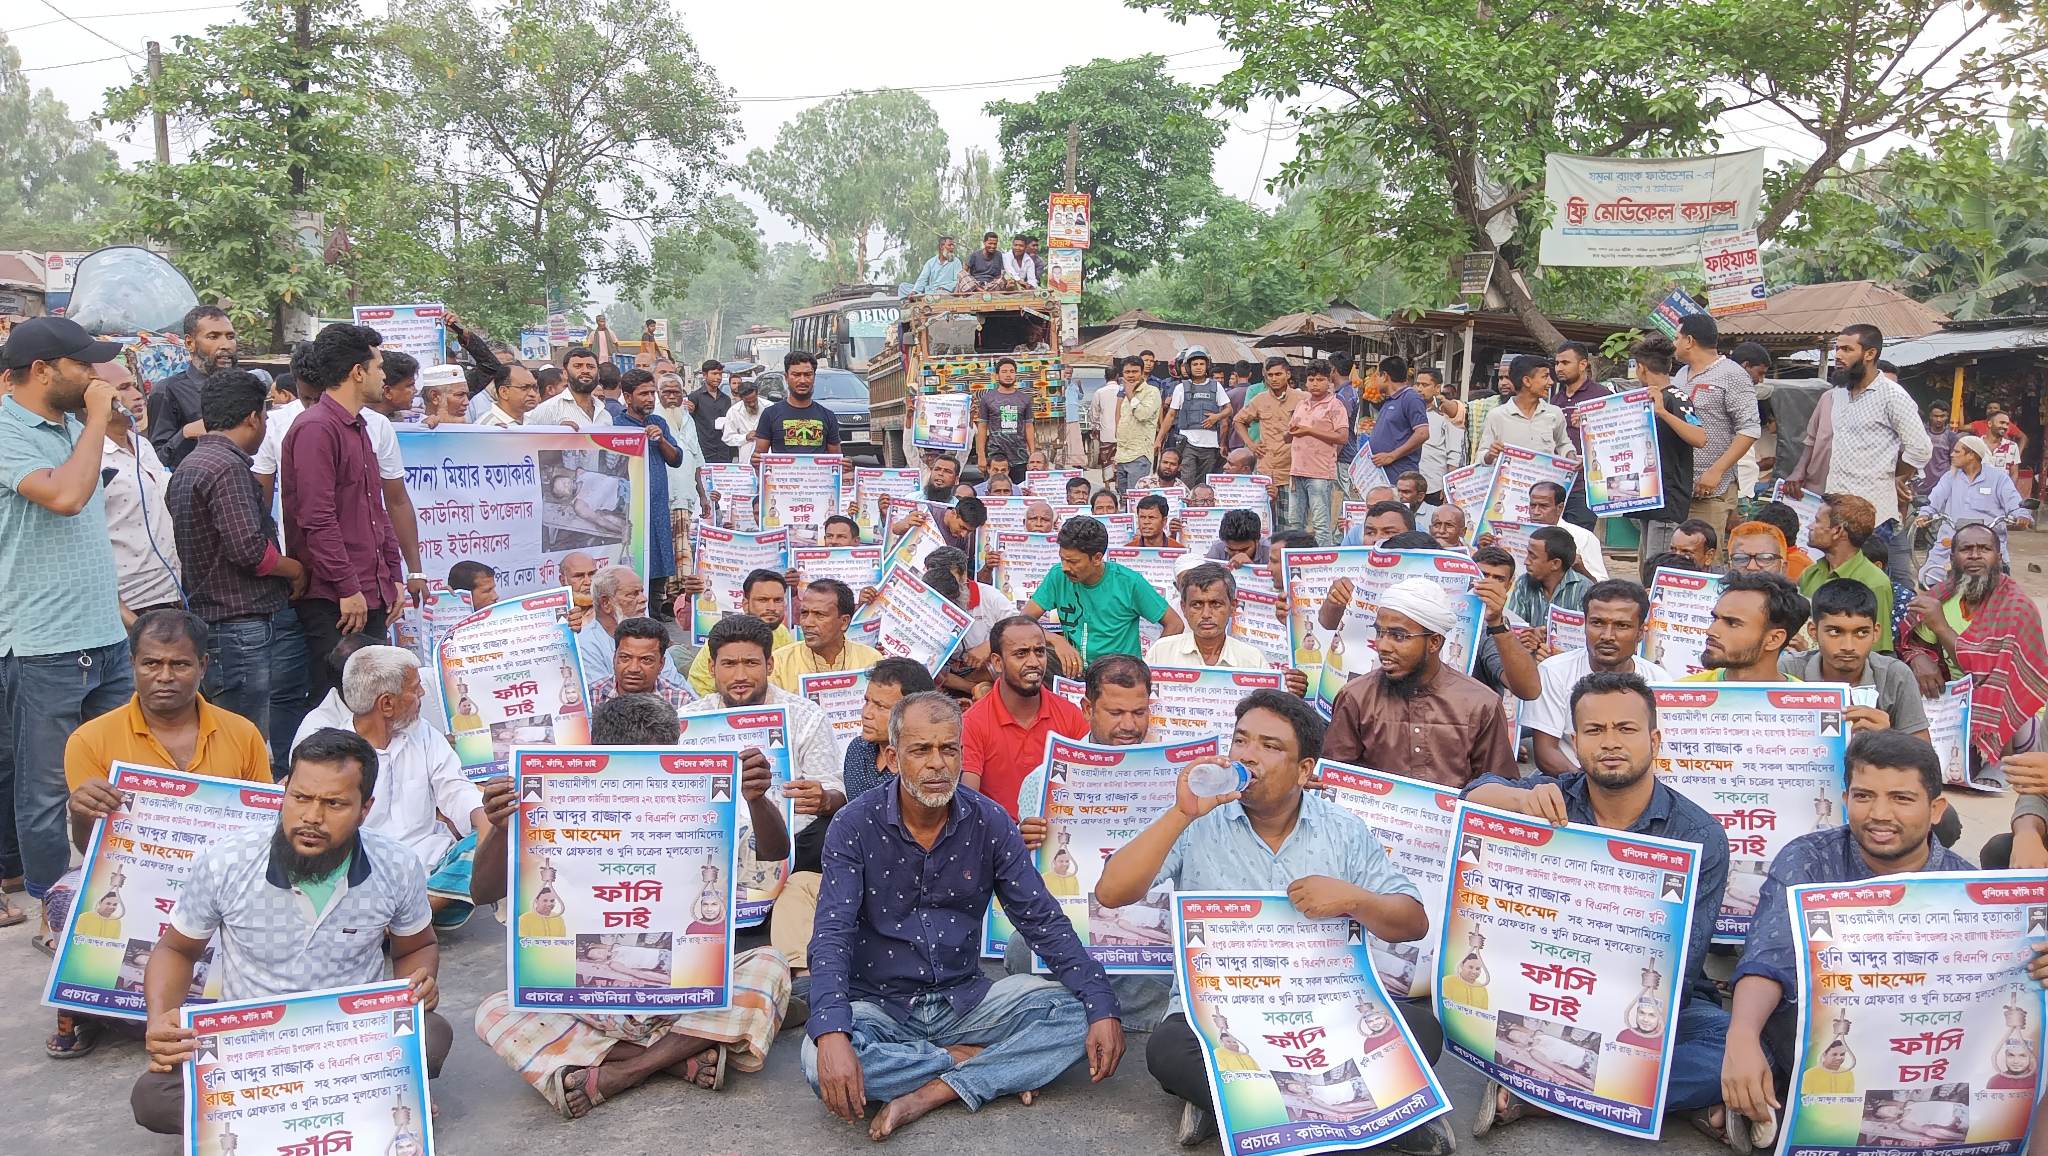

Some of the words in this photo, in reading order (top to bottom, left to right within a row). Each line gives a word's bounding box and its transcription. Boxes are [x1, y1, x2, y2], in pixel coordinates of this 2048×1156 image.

[1567, 196, 1589, 225] ফ্রি
[1594, 196, 1676, 223] মেডিকেল
[1680, 198, 1740, 222] ক্যাম্প
[1705, 249, 1757, 272] ফাইয়াজ
[860, 308, 900, 321] BINO
[1610, 450, 1634, 462] ফাঁসি
[442, 458, 480, 488] মিয়ার
[483, 456, 536, 490] হত্যাকারী
[1615, 462, 1631, 474] চাই
[418, 500, 474, 525] কাউনিয়া
[480, 500, 533, 520] উপজেলার
[788, 503, 815, 512] ফাঁসি
[447, 530, 510, 555] ইউনিয়নের
[513, 567, 536, 587] নেতা
[539, 560, 555, 585] খুনি
[884, 633, 912, 658] ফাঁসি
[493, 681, 538, 701] ফাঁসি
[504, 699, 534, 716] চাই
[1170, 717, 1208, 728] আহম্মেদ
[1668, 742, 1699, 756] আব্দুর
[1703, 742, 1742, 754] রাজ্জাক
[1676, 757, 1734, 772] আহম্মেদ
[547, 776, 596, 788] আওয়ামীলীগ
[600, 780, 619, 788] নেতা
[623, 780, 643, 788] সোনা
[646, 777, 668, 788] মিয়ার
[671, 776, 707, 789] হত্যাকারী
[1052, 790, 1069, 803] খুনি
[1073, 793, 1102, 803] আব্দুর
[1105, 793, 1139, 801] রাজ্জাক
[1713, 792, 1769, 804] সকলের
[526, 808, 548, 826] খুনি
[553, 810, 587, 826] আব্দুর
[591, 810, 632, 823] রাজ্জাক
[645, 812, 676, 823] বিএনপি
[680, 814, 698, 822] নেতা
[702, 811, 720, 824] খুনি
[1050, 804, 1074, 816] রাজু
[1079, 804, 1128, 815] আহম্মেদ
[111, 817, 133, 837] খুনি
[137, 826, 168, 842] আব্দুর
[172, 831, 207, 845] রাজ্জাক
[529, 829, 556, 844] রাজু
[561, 829, 621, 842] আহম্মেদ
[630, 832, 645, 841] সহ
[648, 832, 672, 840] সকল
[675, 830, 723, 839] আসামিদের
[108, 836, 134, 852] রাজু
[140, 840, 195, 862] আহম্মেদ
[529, 846, 562, 856] অবিলম্বে
[566, 847, 602, 856] গ্রেফতার
[606, 848, 613, 856] ও
[617, 845, 633, 858] খুনি
[636, 848, 662, 856] চক্রের
[666, 847, 703, 858] মূলহোতা
[707, 846, 719, 856] সহ
[598, 863, 656, 875] সকলের
[1486, 843, 1537, 861] আওয়ামীলীগ
[1541, 855, 1561, 866] নেতা
[1565, 859, 1587, 871] সোনা
[1591, 860, 1615, 876] মিয়ার
[1618, 868, 1658, 883] হত্যাকারী
[592, 879, 663, 904] ফাঁসি
[1460, 869, 1484, 890] খুনি
[1488, 877, 1523, 897] আব্দুর
[1528, 885, 1572, 904] রাজ্জাক
[603, 907, 651, 930] চাই
[1461, 892, 1489, 912] রাজু
[1494, 898, 1558, 922] আহম্মেদ
[1568, 915, 1583, 927] সহ
[1587, 919, 1613, 932] সকল
[1616, 924, 1671, 942] আসামিদের
[1460, 908, 1494, 926] অবিলম্বে
[1498, 918, 1536, 932] গ্রেফতার
[1540, 927, 1547, 935] ও
[1552, 927, 1569, 940] খুনি
[1572, 933, 1600, 946] চক্রের
[1604, 939, 1646, 955] মূলহোতা
[1650, 948, 1664, 961] সহ
[1092, 950, 1138, 964] কাউনিয়া
[1192, 953, 1211, 974] খুনি
[1215, 957, 1247, 972] আব্দুর
[1251, 956, 1289, 968] রাজ্জাক
[1531, 940, 1592, 965] সকলের
[1817, 947, 1842, 968] খুনি
[1848, 952, 1887, 970] আব্দুর
[1892, 952, 1939, 966] রাজ্জাক
[1196, 977, 1222, 992] রাজু
[1224, 975, 1281, 989] আহম্মেদ
[1521, 963, 1597, 995] ফাঁসি
[1822, 974, 1854, 991] রাজু
[1858, 973, 1927, 989] আহম্মেদ
[526, 992, 564, 1006] প্রচারে
[578, 990, 631, 1006] কাউনিয়া
[634, 988, 716, 1006] উপজেলাবাসী
[1529, 993, 1581, 1022] চাই
[1263, 1011, 1314, 1025] সকলের
[1900, 1011, 1963, 1026] সকলের
[1262, 1026, 1326, 1050] ফাঁসি
[1889, 1028, 1964, 1055] ফাঁসি
[1283, 1048, 1329, 1070] চাই
[1899, 1059, 1949, 1082] চাই
[201, 1068, 226, 1089] খুনি
[230, 1066, 266, 1082] আব্দুর
[271, 1060, 314, 1076] রাজ্জাক
[206, 1091, 236, 1108] রাজু
[240, 1081, 304, 1100] আহম্মেদ
[1498, 1070, 1550, 1100] কাউনিয়া
[1553, 1085, 1643, 1125] উপজেলাবাসী
[282, 1112, 344, 1132] সকলের
[1241, 1133, 1280, 1150] প্রচারে
[1294, 1122, 1347, 1148] কাউনিয়া
[1348, 1095, 1428, 1136] উপজেলাবাসী
[277, 1130, 354, 1156] ফাঁসি
